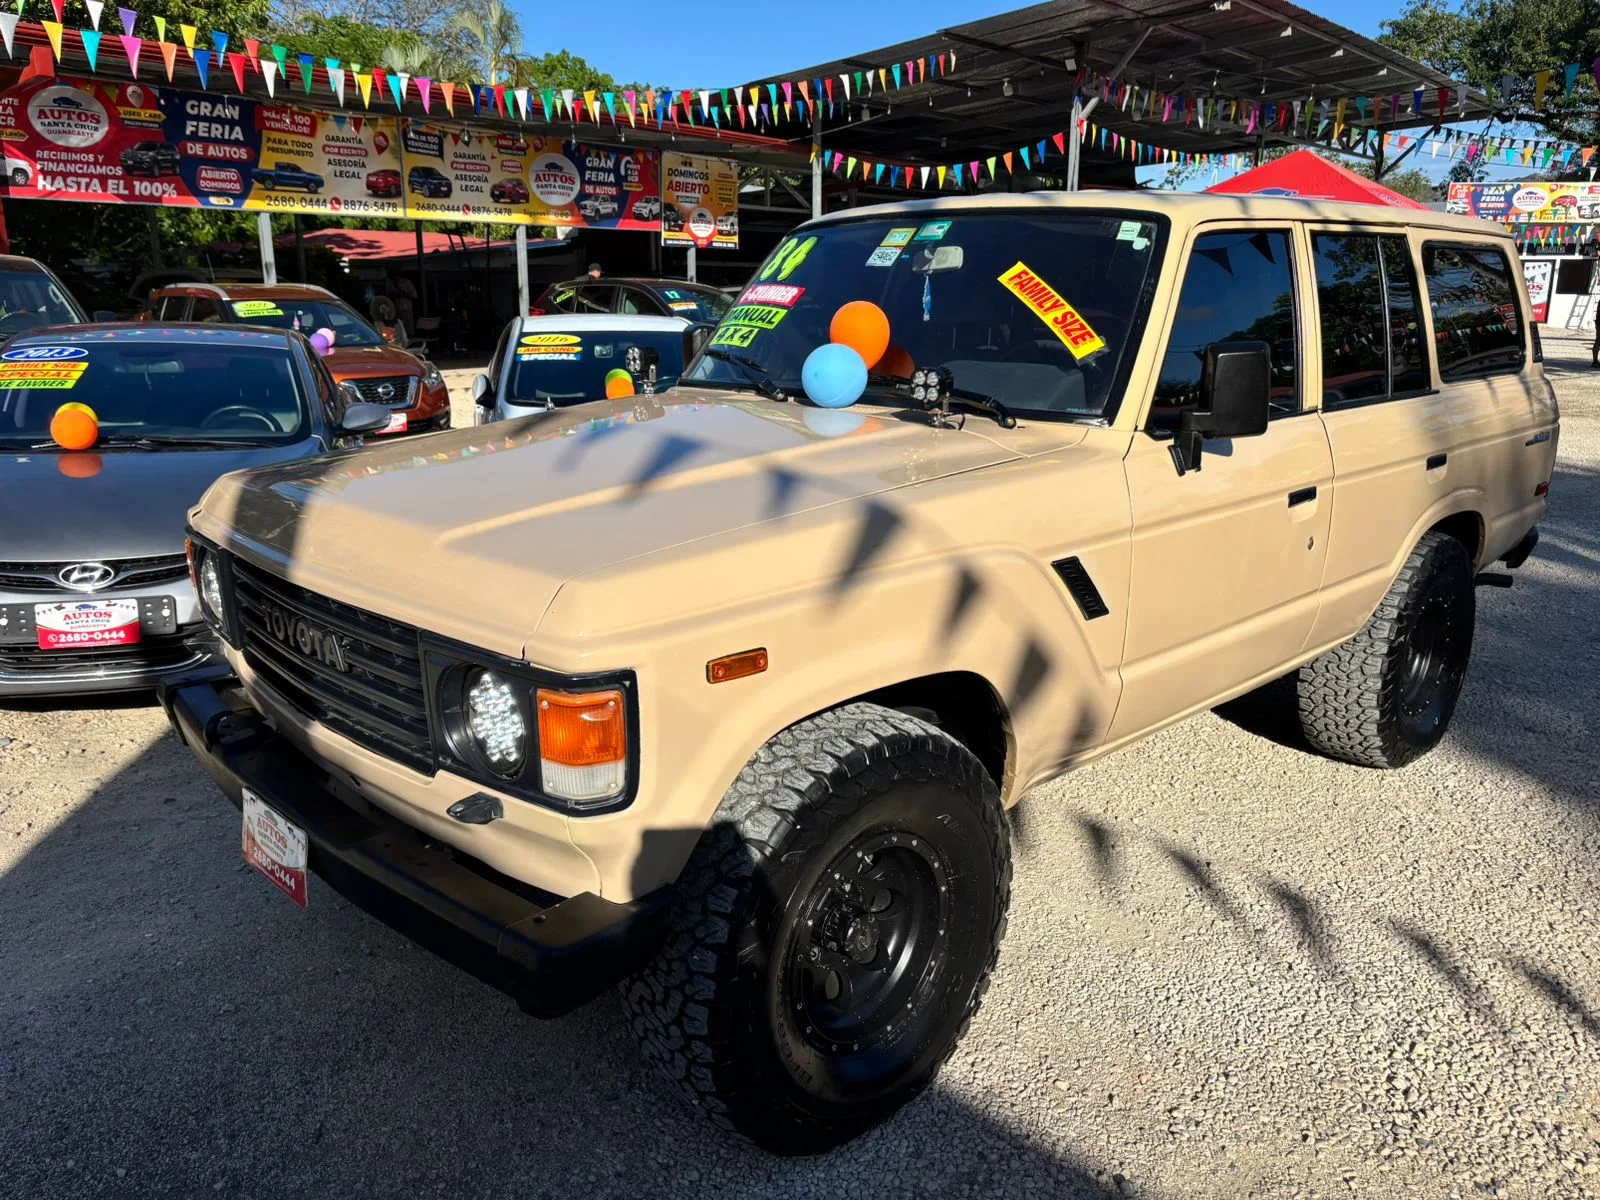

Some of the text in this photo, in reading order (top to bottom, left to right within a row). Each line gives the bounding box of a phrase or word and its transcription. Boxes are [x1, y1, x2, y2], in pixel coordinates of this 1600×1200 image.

[0, 97, 20, 106] NTE
[122, 109, 162, 120] USED CARS
[185, 99, 240, 120] GRAN
[0, 116, 16, 127] CR
[37, 108, 102, 125] AUTOS
[294, 115, 311, 126] 100
[47, 129, 94, 138] GUANACASTE
[74, 123, 99, 132] CRUZ
[185, 120, 245, 142] FERIA
[266, 136, 313, 149] PARA TODO
[324, 134, 363, 145] GARANTÍA
[35, 150, 105, 163] RECIBIMOS Y
[186, 142, 248, 160] DE AUTOS
[266, 146, 314, 158] PRESUPUESTO
[324, 146, 366, 157] POR ESCRITO
[453, 151, 487, 161] GARANTÍA
[327, 157, 367, 169] ASESORÍA
[466, 164, 489, 172] ESCRITO
[585, 156, 615, 169] GRAN
[36, 162, 123, 177] FINANCIAMOS
[201, 169, 238, 181] ABIERTO
[334, 170, 362, 180] LEGAL
[667, 167, 710, 180] DOMINGOS
[454, 173, 489, 183] ASESORÍA
[534, 172, 576, 186] AUTOS
[585, 170, 616, 183] FERIA
[37, 174, 178, 198] HASTA EL 100%
[199, 180, 240, 190] DOMINGOS
[460, 184, 485, 193] LEGAL
[557, 184, 574, 192] CRUZ
[585, 185, 594, 193] DE
[595, 186, 617, 195] AUTOS
[667, 180, 710, 195] ABIERTO
[265, 195, 398, 213] 2680-0444 8876-5478
[415, 202, 513, 216] 2680-0444 8876-5478
[759, 236, 818, 282] 84
[664, 290, 681, 299] 17
[1008, 269, 1096, 348] FAMILY SIZE
[531, 335, 569, 343] 2016
[14, 348, 76, 358] 2013
[520, 353, 577, 361] SPECIAL
[0, 370, 73, 378] SPECIAL
[16, 380, 68, 388] OWNER
[63, 611, 113, 621] AUTOS
[59, 630, 125, 643] 2680-0444
[261, 603, 349, 673] TOYOTA
[256, 816, 288, 849] AUTOS
[257, 829, 273, 845] SANTA
[253, 846, 296, 890] 2680-0444
